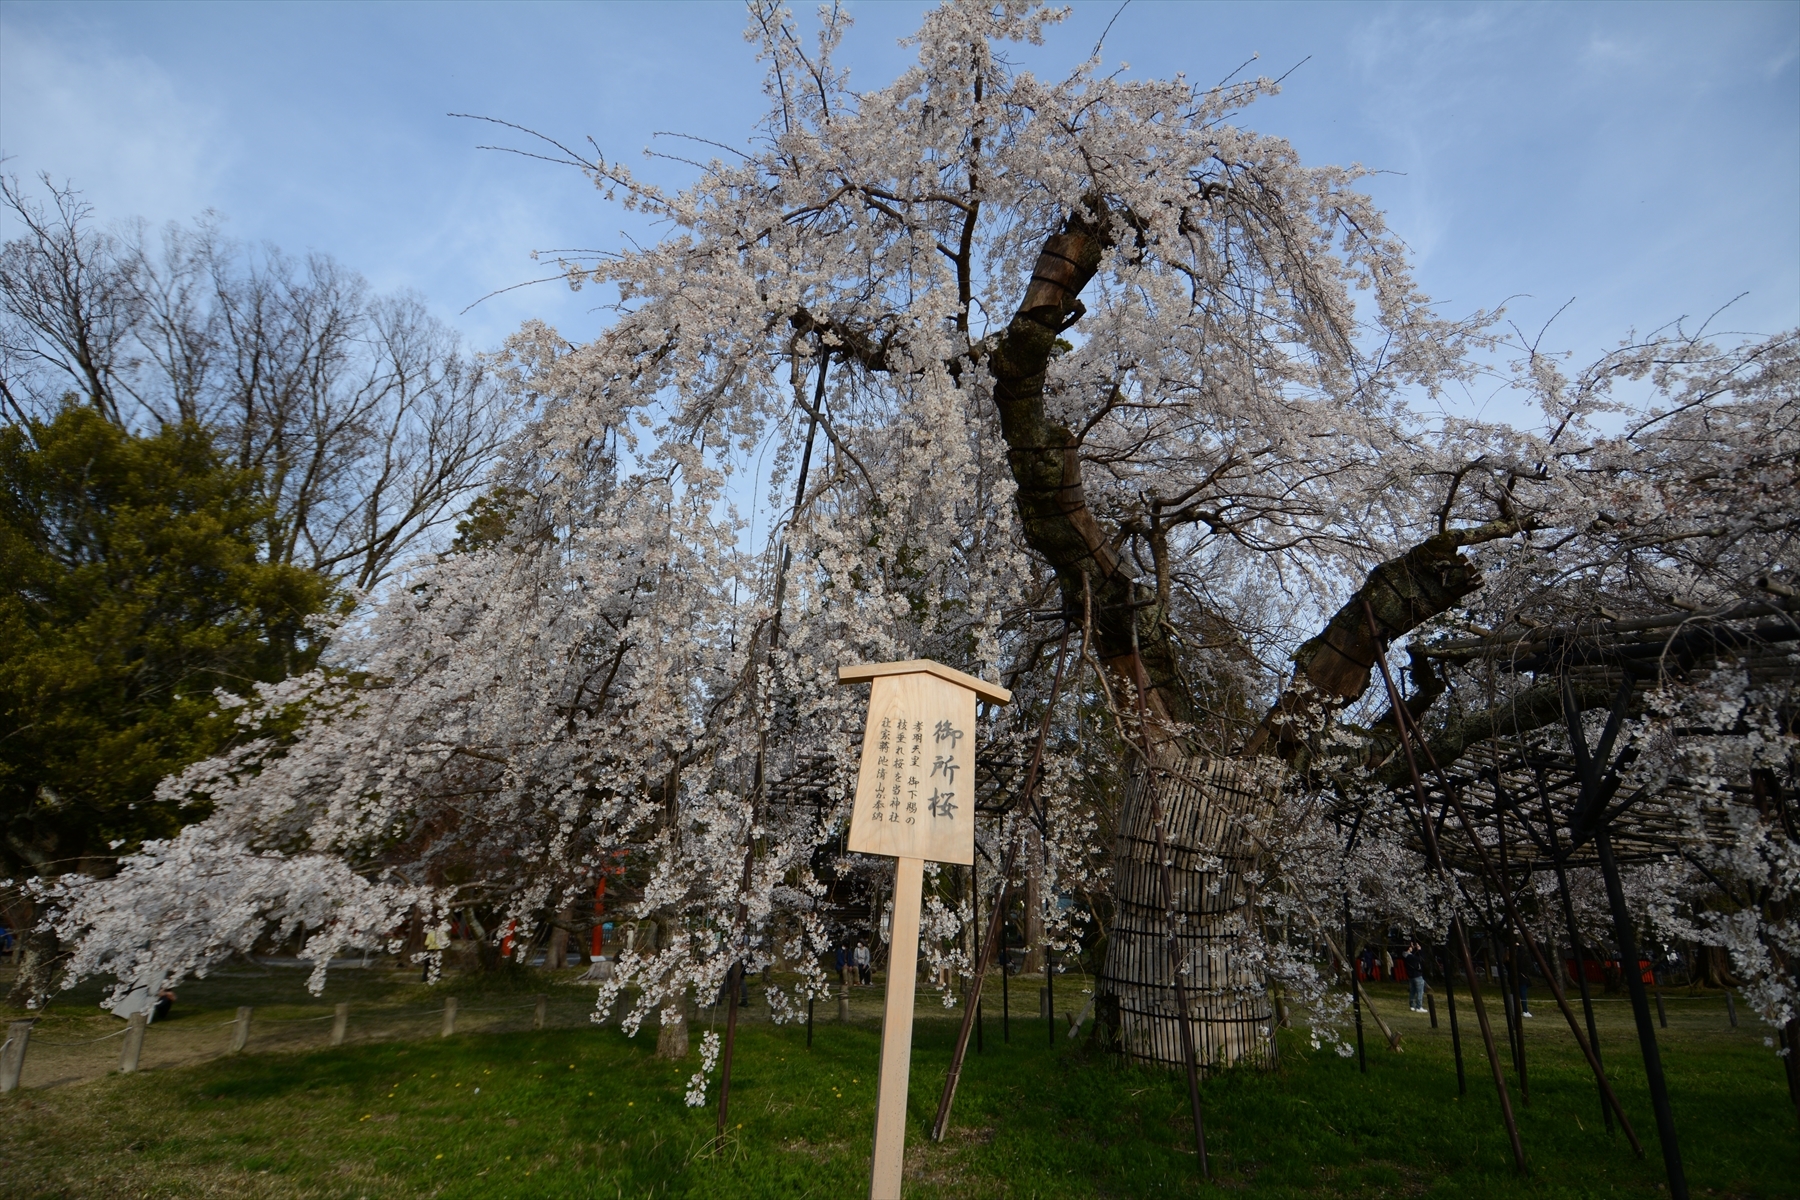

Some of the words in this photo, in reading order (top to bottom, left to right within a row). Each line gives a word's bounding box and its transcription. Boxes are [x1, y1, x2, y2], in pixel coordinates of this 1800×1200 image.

[888, 718, 908, 824] 枝垂れ桜を当神社
[910, 720, 924, 768] 孝明天皇
[927, 719, 964, 820] 御所桜
